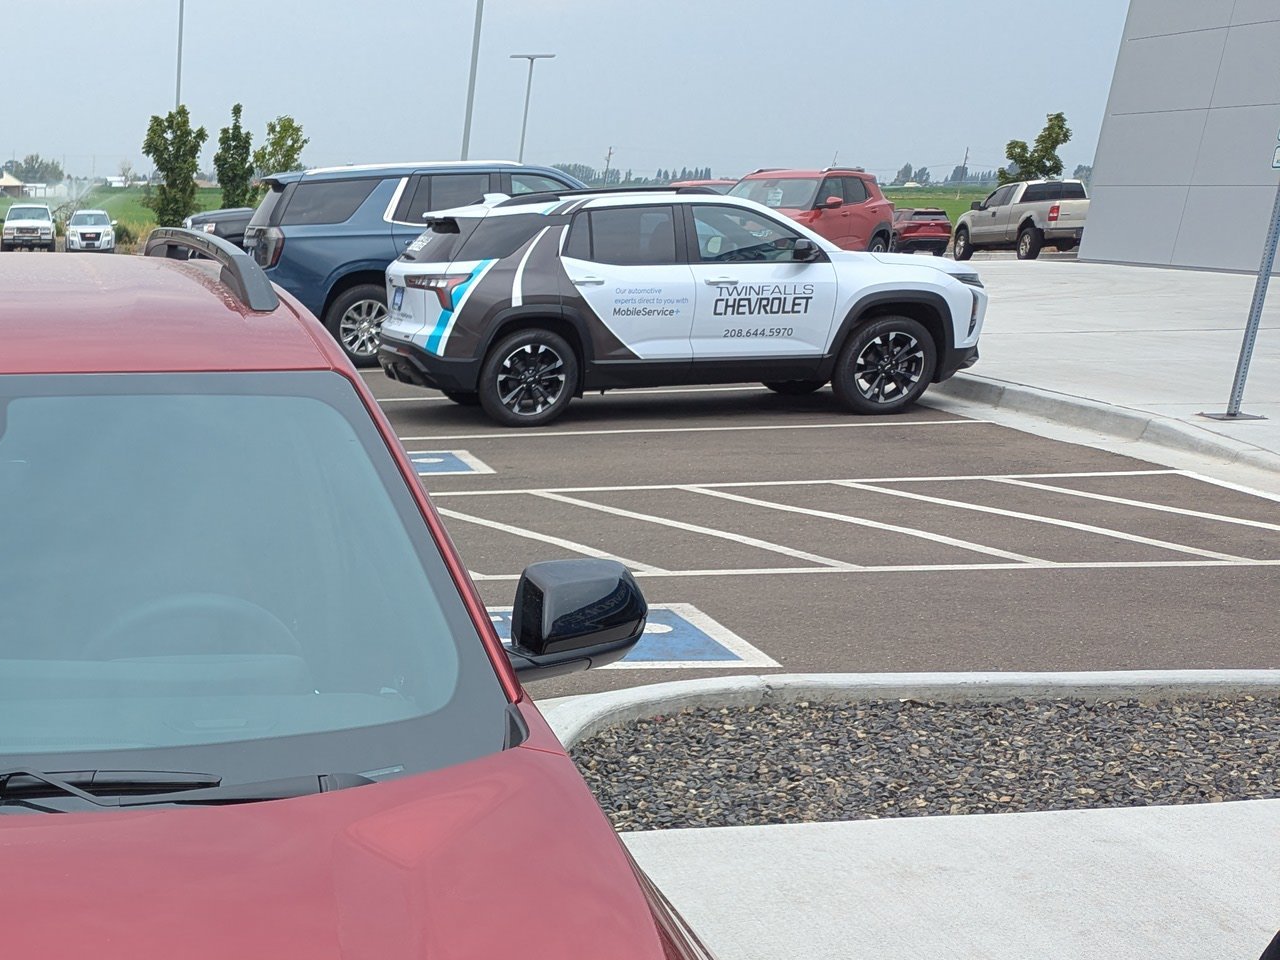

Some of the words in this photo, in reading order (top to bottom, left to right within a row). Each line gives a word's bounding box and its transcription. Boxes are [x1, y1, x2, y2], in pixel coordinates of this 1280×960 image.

[716, 284, 814, 297] TWINFALLS
[614, 297, 637, 305] experts
[713, 296, 813, 316] CHEVROLET
[612, 306, 680, 317] MobileService+
[722, 327, 794, 338] 208.644.5970
